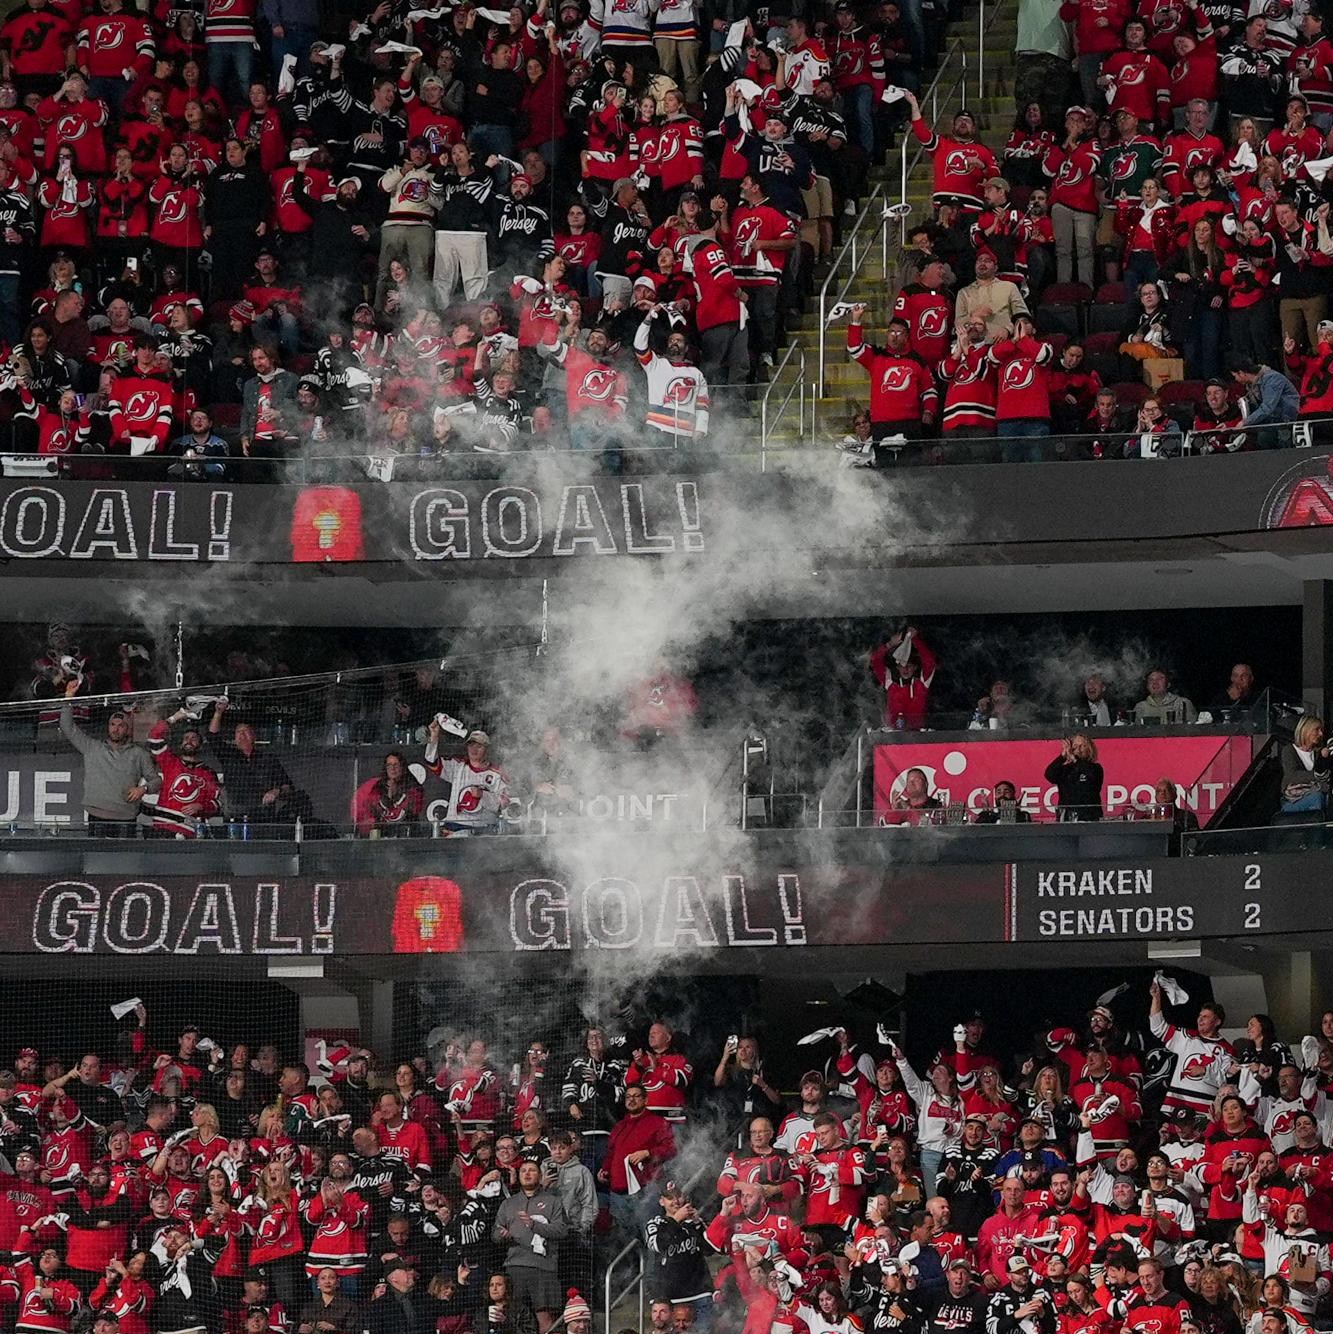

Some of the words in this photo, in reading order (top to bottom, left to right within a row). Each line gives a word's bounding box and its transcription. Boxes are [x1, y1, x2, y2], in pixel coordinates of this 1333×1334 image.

[793, 115, 831, 137] Jersey
[759, 155, 787, 174] US
[500, 211, 537, 238] Jersey
[410, 481, 706, 560] GOAL!
[1038, 869, 1153, 898] KRAKEN
[1245, 864, 1260, 890] 2
[33, 882, 339, 955] GOAL!
[509, 873, 807, 952] GOAL!
[1039, 905, 1195, 938] SENATORS
[1245, 903, 1260, 929] 2
[353, 1169, 393, 1191] Jersey
